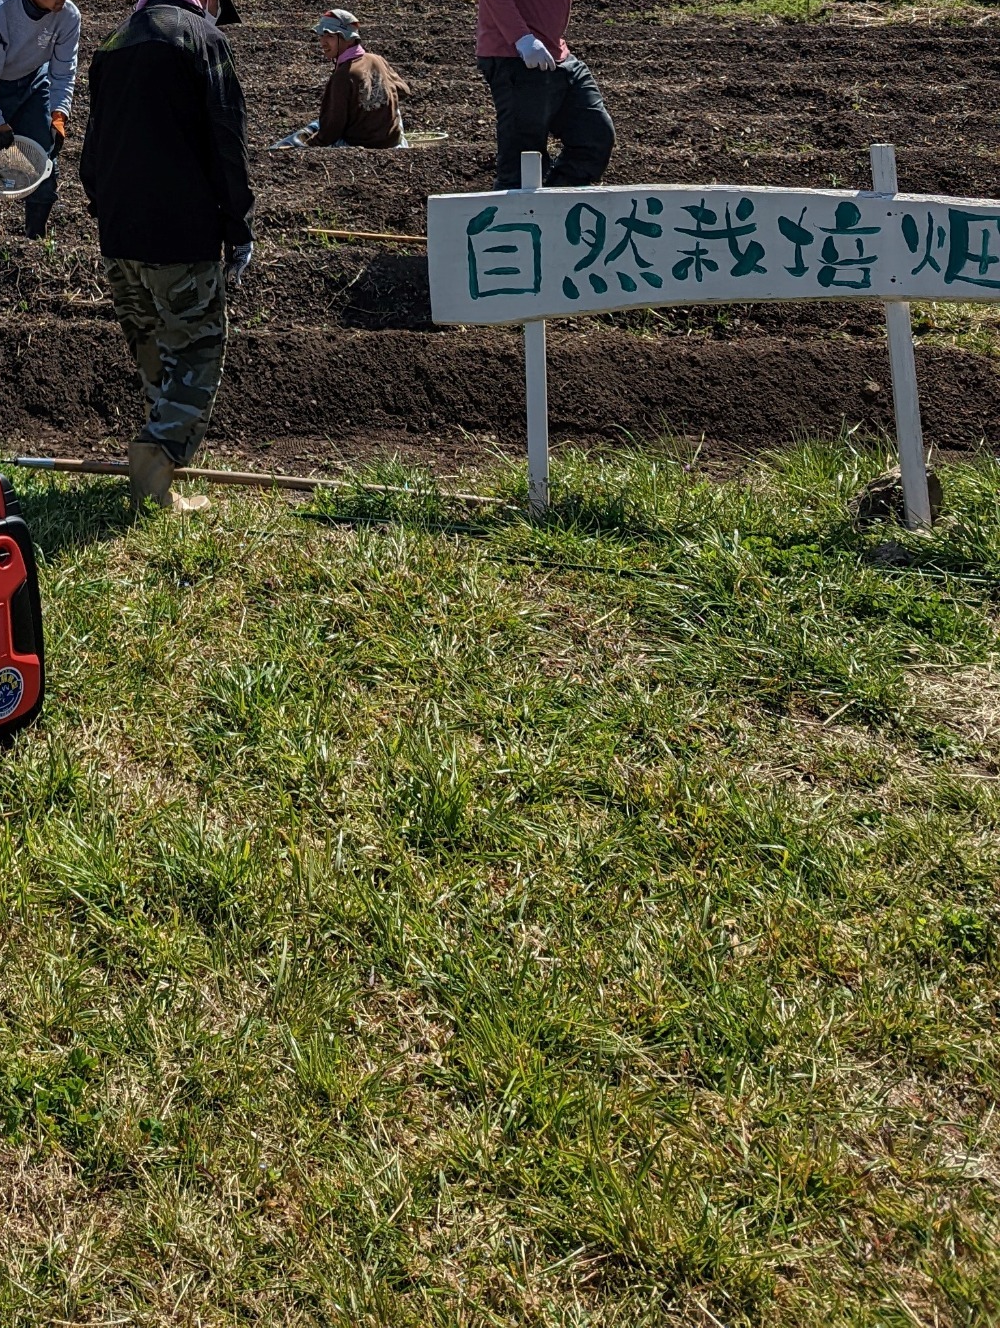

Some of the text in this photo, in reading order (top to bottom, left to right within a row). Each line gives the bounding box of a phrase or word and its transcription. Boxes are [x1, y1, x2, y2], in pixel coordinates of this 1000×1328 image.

[467, 196, 1000, 300] 自然栽培畑
